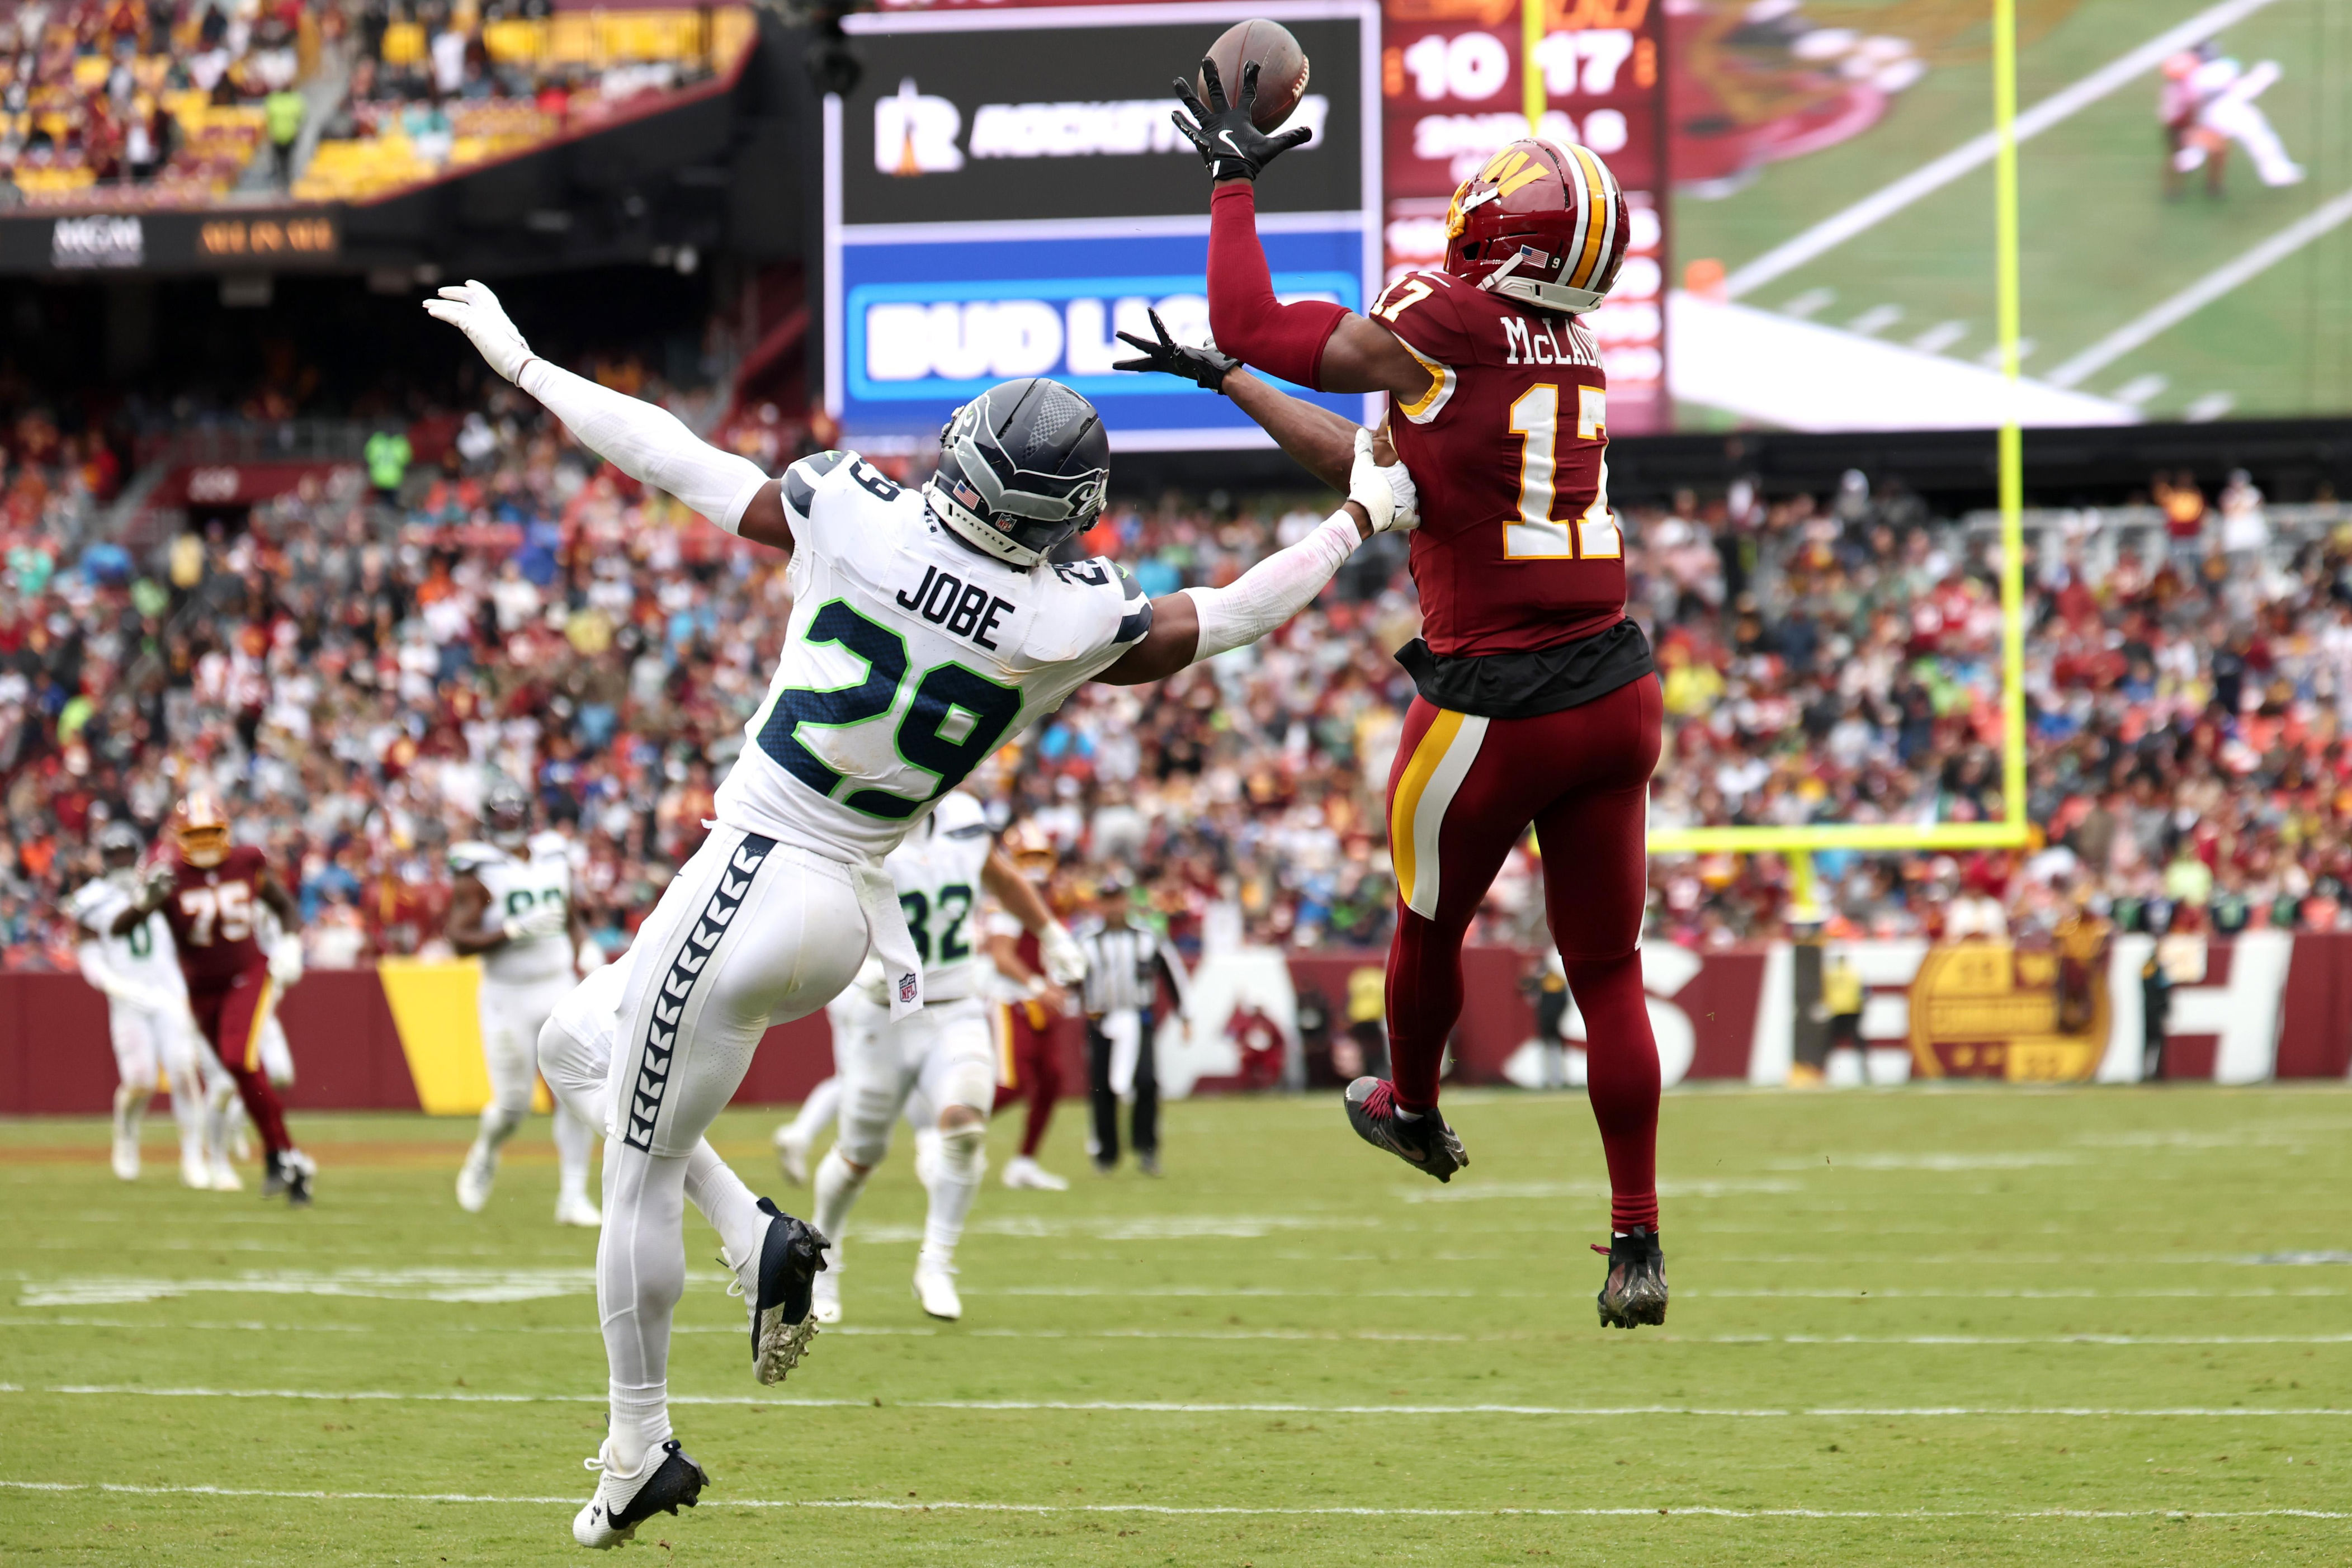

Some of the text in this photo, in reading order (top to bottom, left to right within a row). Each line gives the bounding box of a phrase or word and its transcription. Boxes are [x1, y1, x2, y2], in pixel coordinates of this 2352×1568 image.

[1404, 28, 1633, 101] 10 17
[1551, 257, 1561, 268] 9
[1370, 275, 1434, 323] 17
[865, 298, 1063, 381] BUD
[1503, 383, 1621, 559] 17
[956, 513, 1004, 546] SEATTLE
[998, 519, 1013, 531] NFL
[896, 565, 1016, 651] JOBE
[757, 597, 1024, 821] 29
[178, 879, 252, 947] 75
[901, 984, 915, 999] NFL
